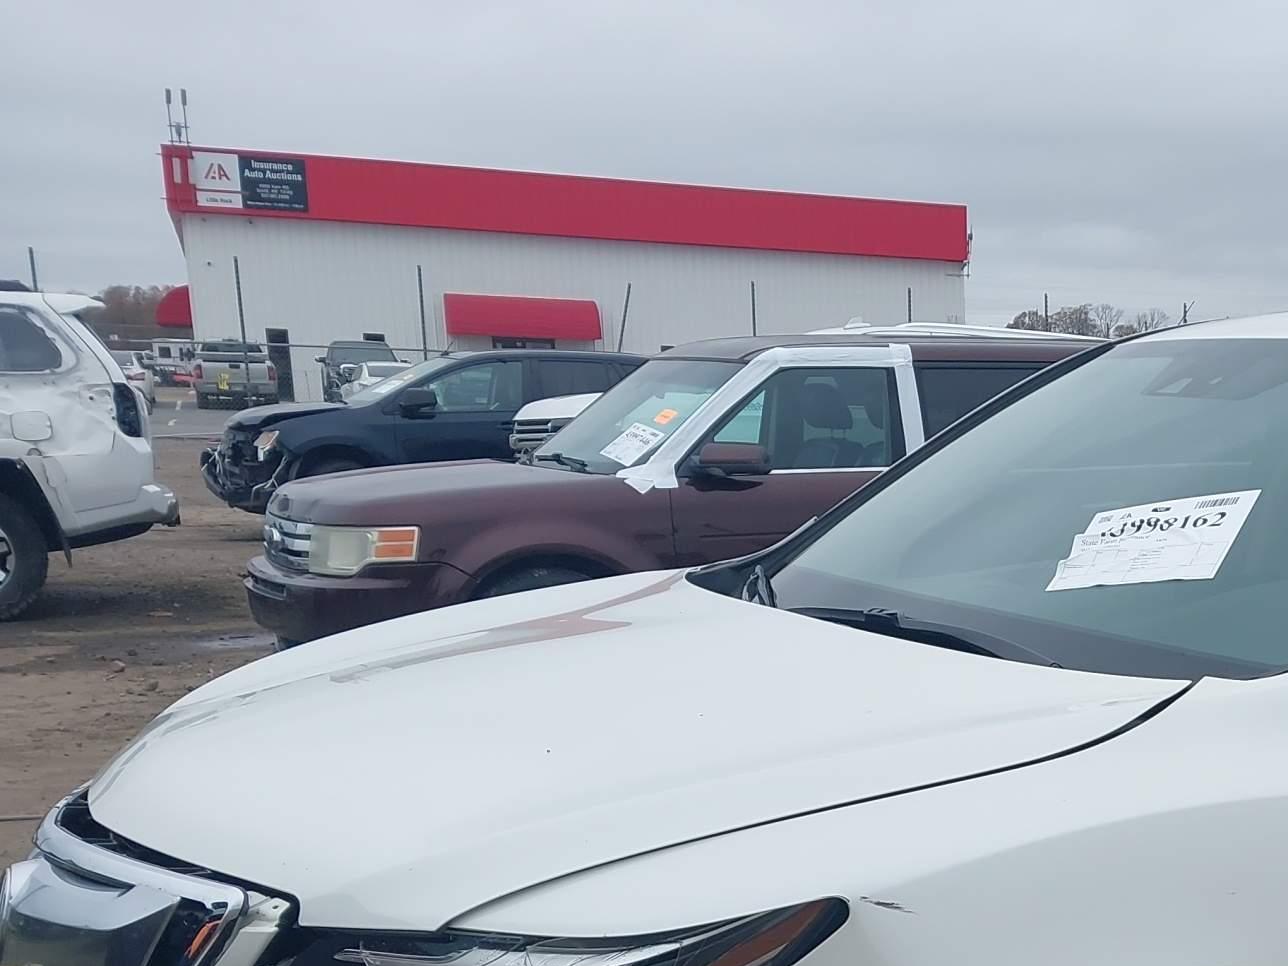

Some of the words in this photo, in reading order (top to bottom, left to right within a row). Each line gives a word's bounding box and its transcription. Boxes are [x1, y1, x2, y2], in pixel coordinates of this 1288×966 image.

[251, 160, 293, 171] Insurance
[244, 169, 263, 178] Auto
[265, 170, 302, 181] Auctions
